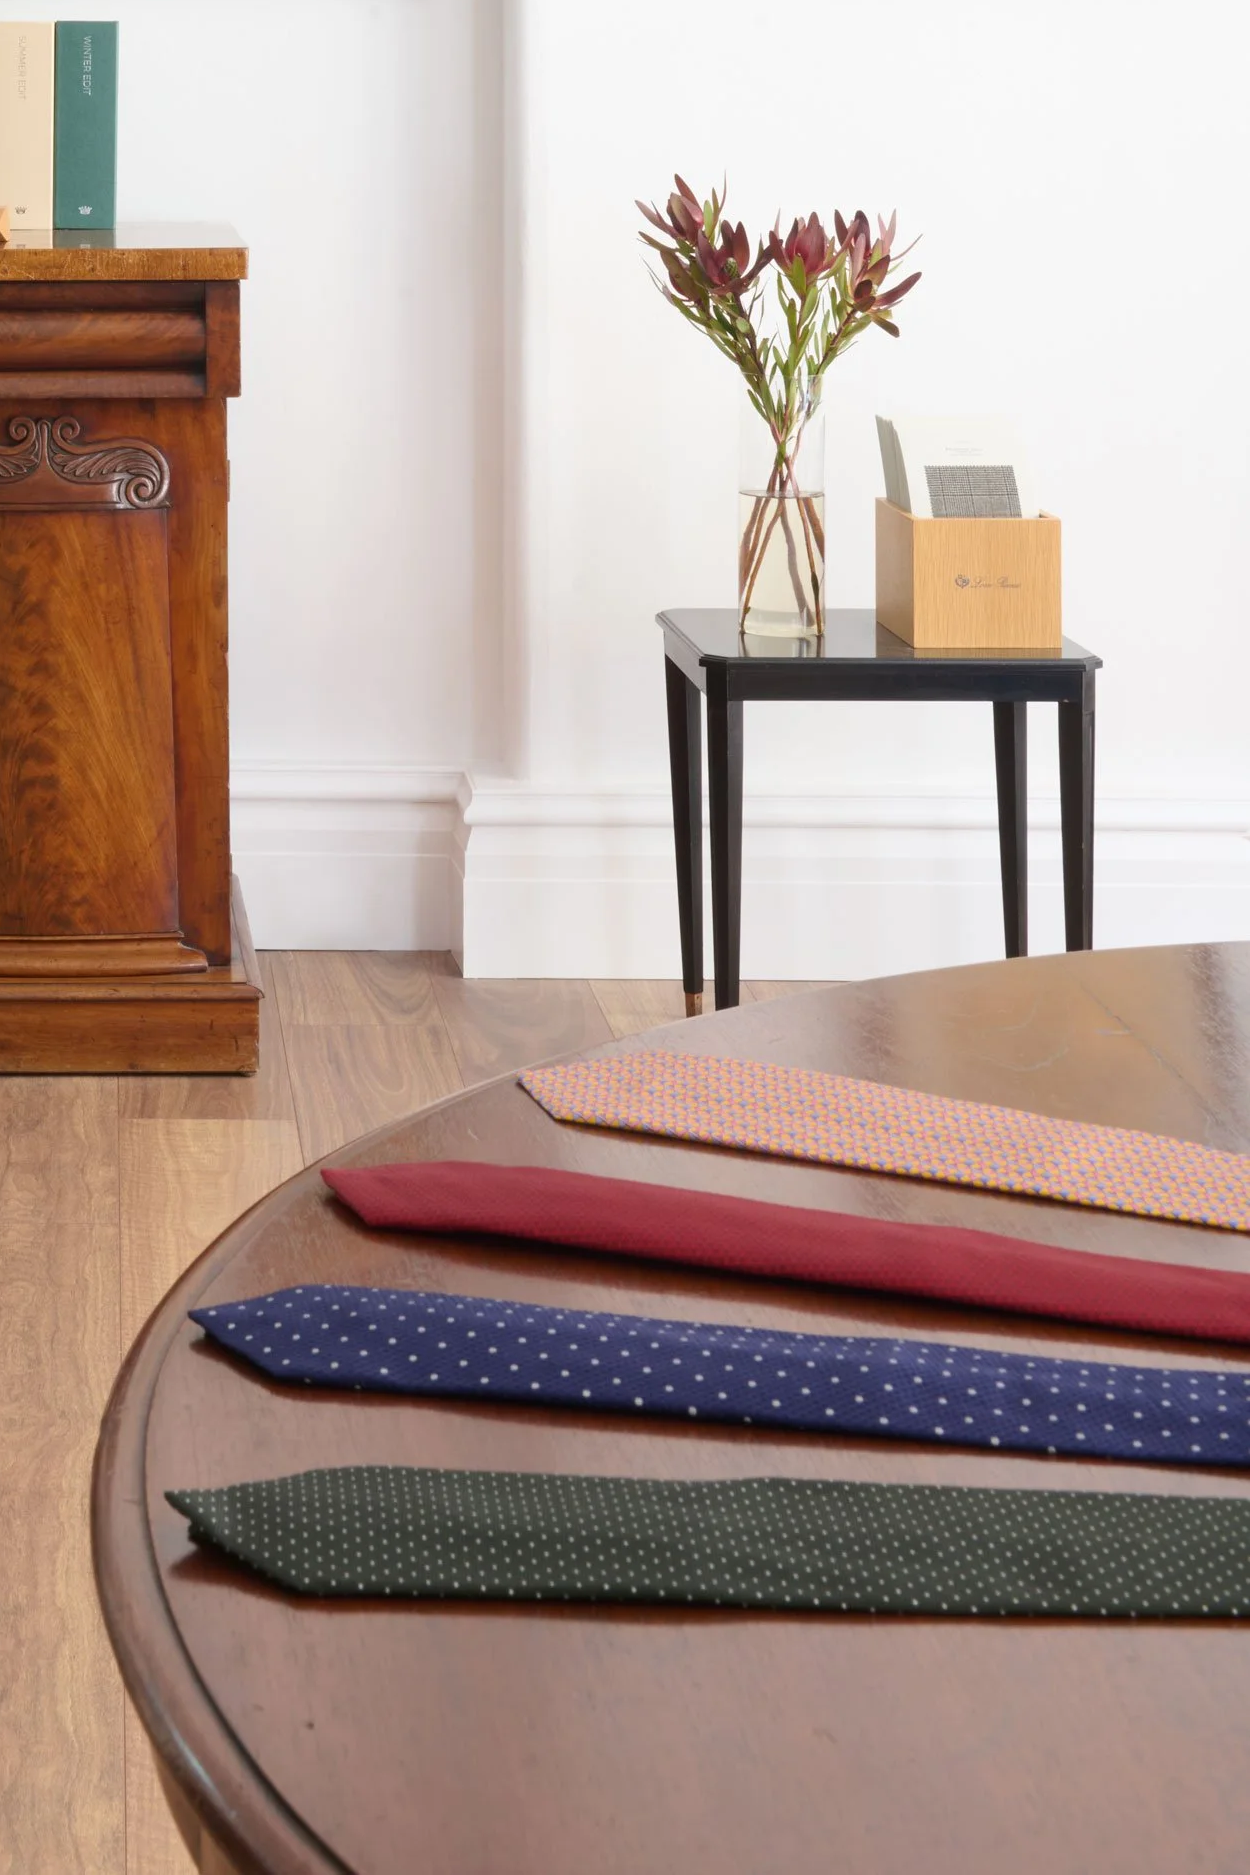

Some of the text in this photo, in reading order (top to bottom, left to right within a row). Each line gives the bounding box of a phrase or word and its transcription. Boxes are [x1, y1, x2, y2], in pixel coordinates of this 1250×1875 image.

[17, 36, 27, 100] SUMMER EDIT
[82, 36, 92, 96] WINTER EDIT
